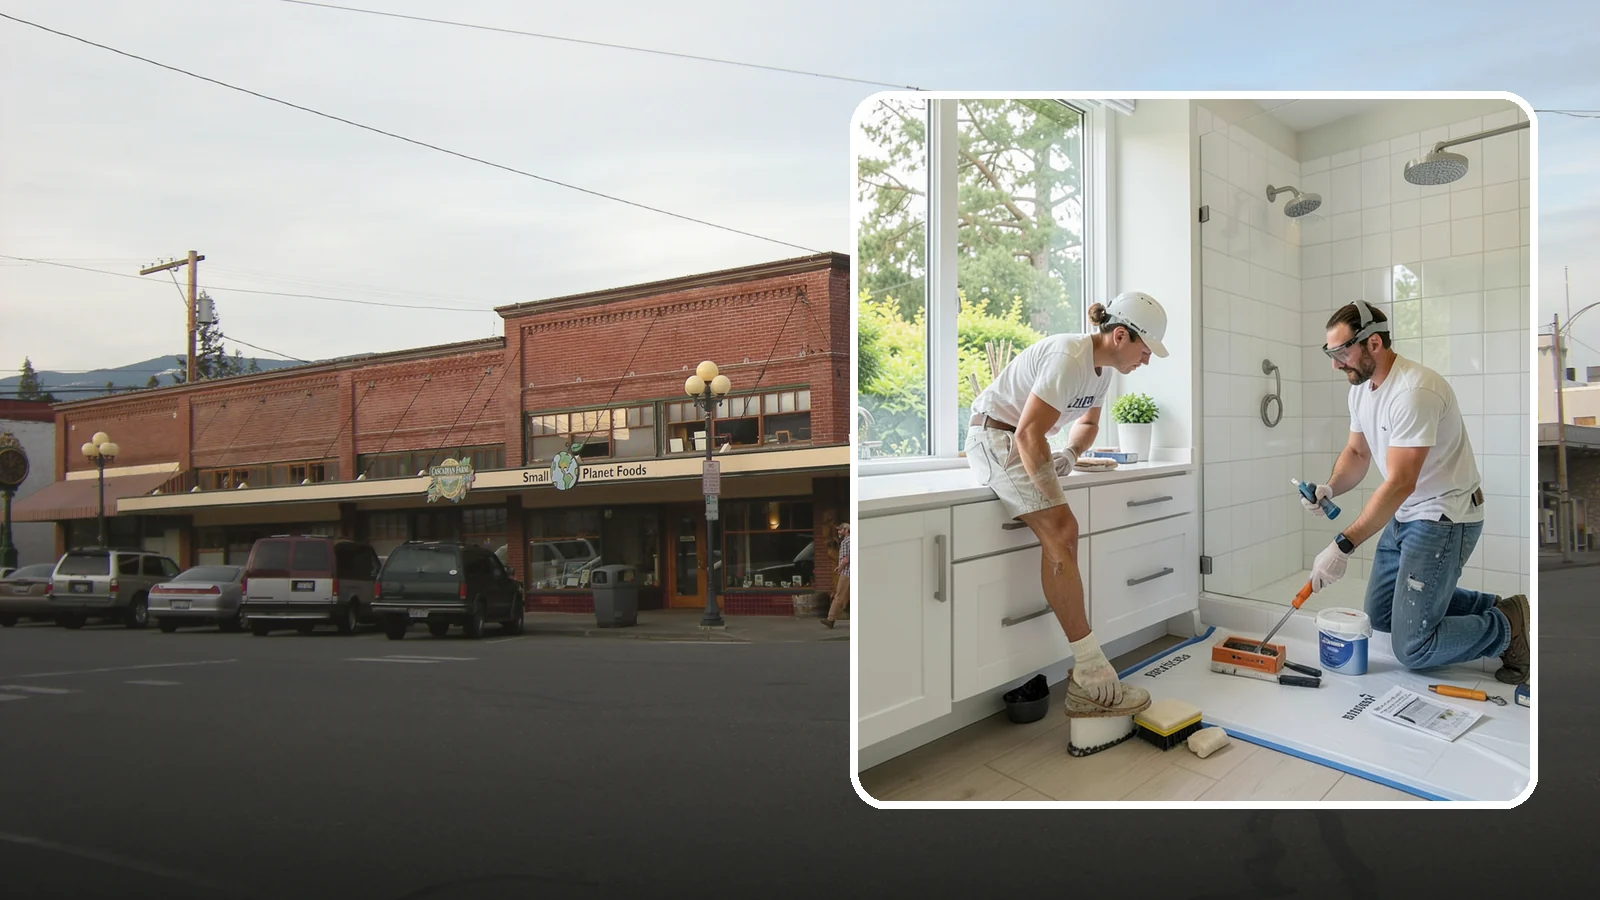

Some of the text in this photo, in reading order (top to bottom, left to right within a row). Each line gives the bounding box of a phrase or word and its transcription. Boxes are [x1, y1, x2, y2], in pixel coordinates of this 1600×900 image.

[522, 464, 647, 483] Small Planet Foods
